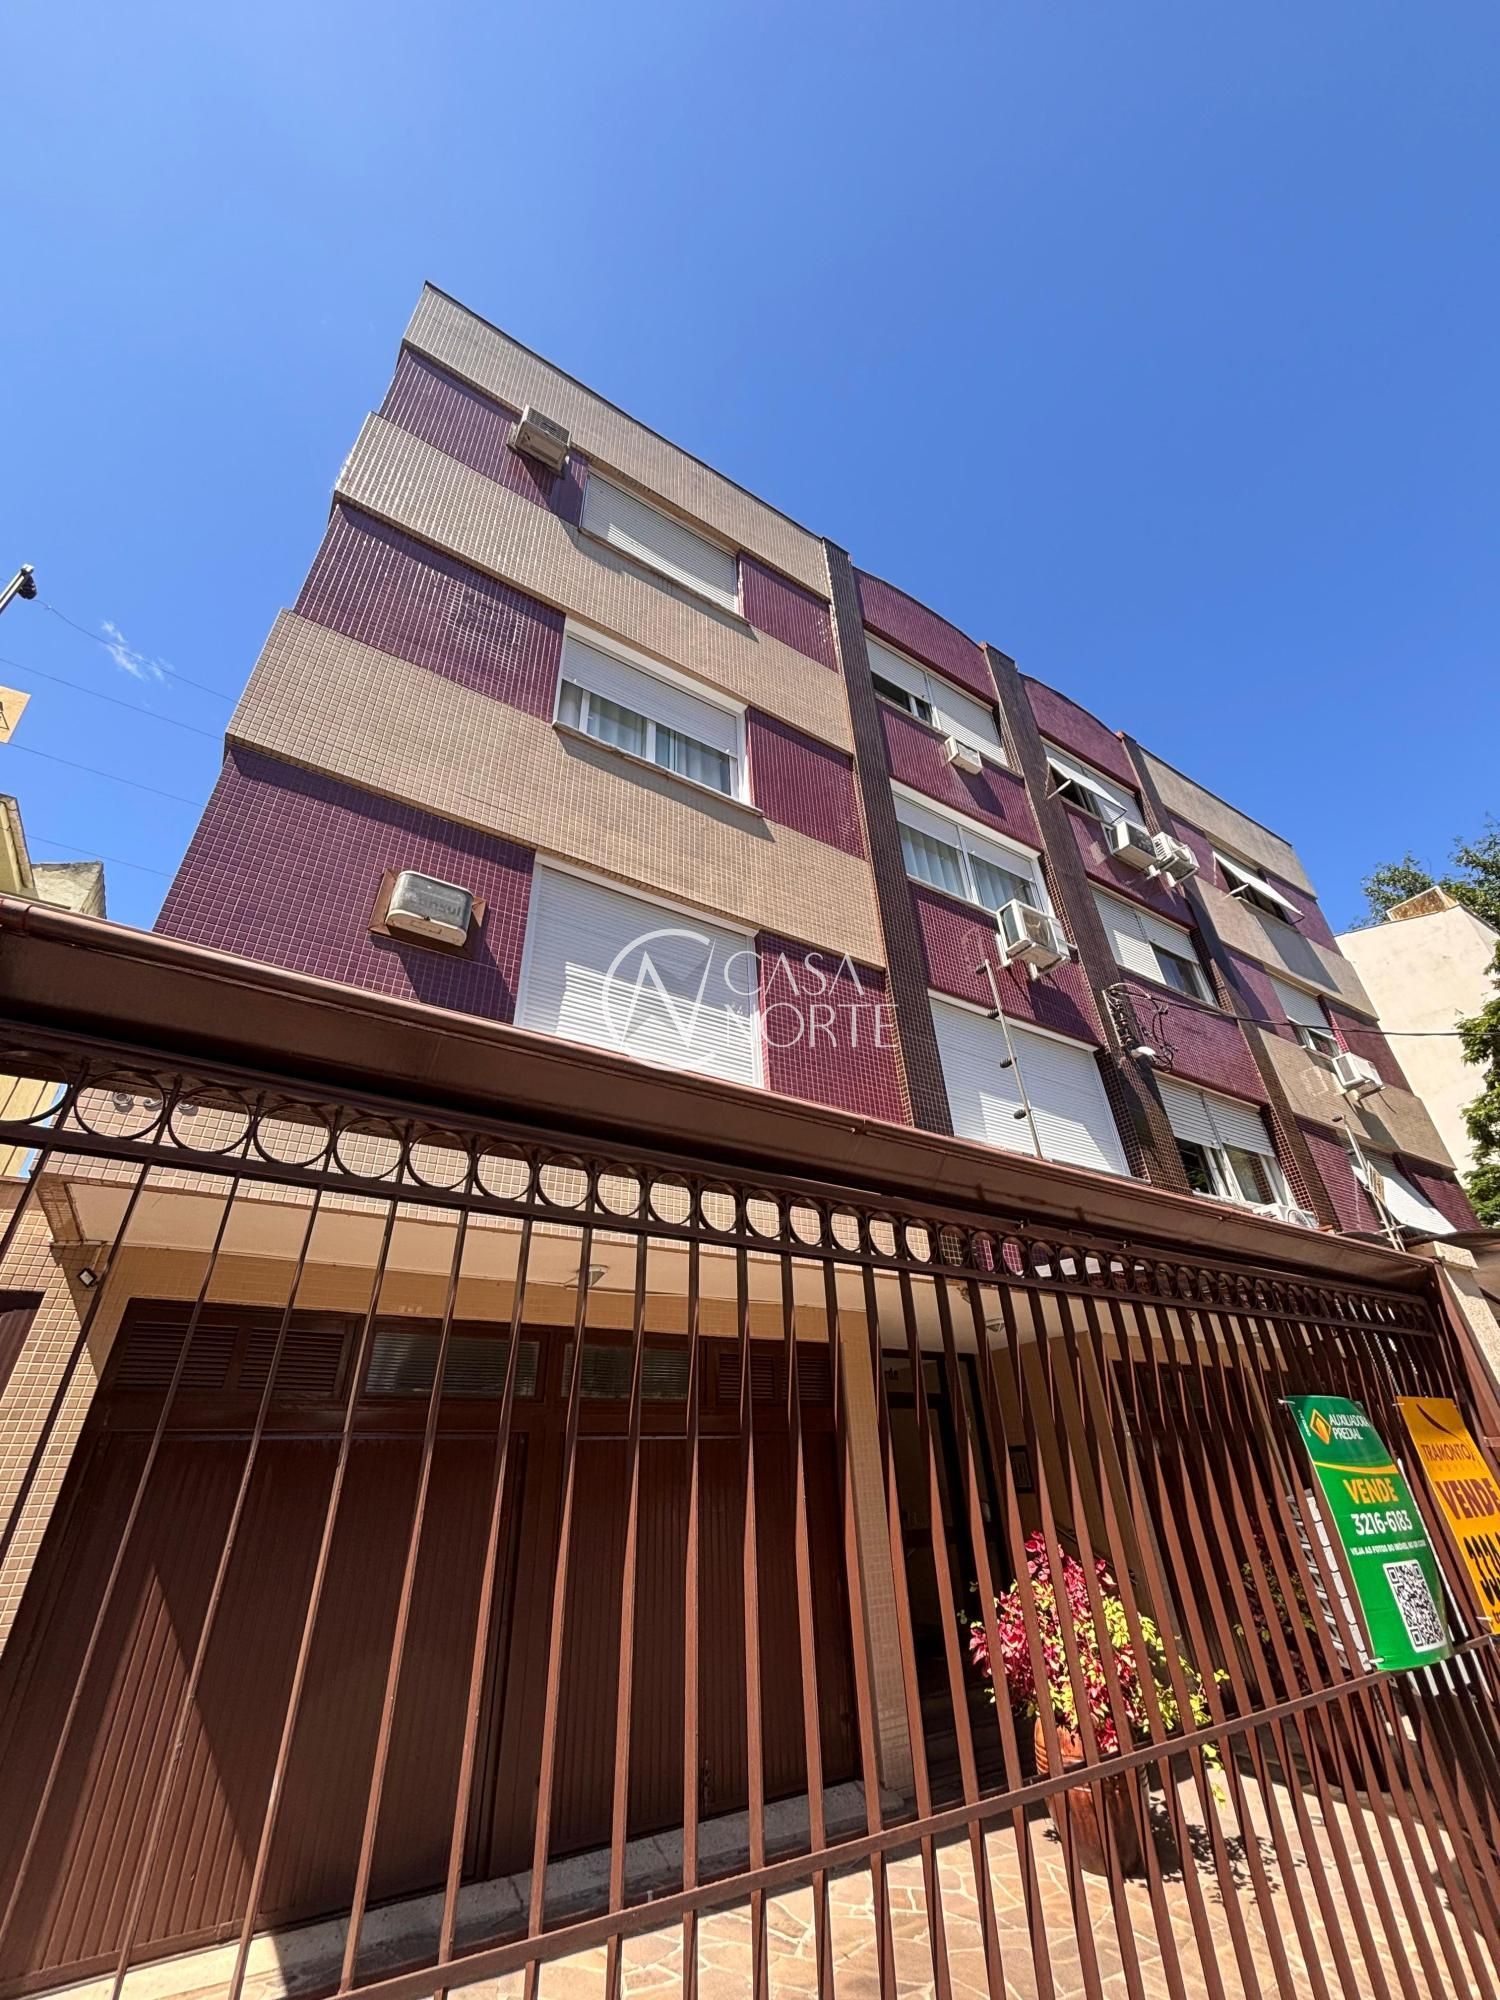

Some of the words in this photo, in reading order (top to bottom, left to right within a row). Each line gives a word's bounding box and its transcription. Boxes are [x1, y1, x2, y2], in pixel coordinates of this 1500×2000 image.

[1331, 1427, 1364, 1440] PREDIAL
[1343, 1478, 1398, 1504] VENDE
[1350, 1509, 1412, 1536] 3216-6183
